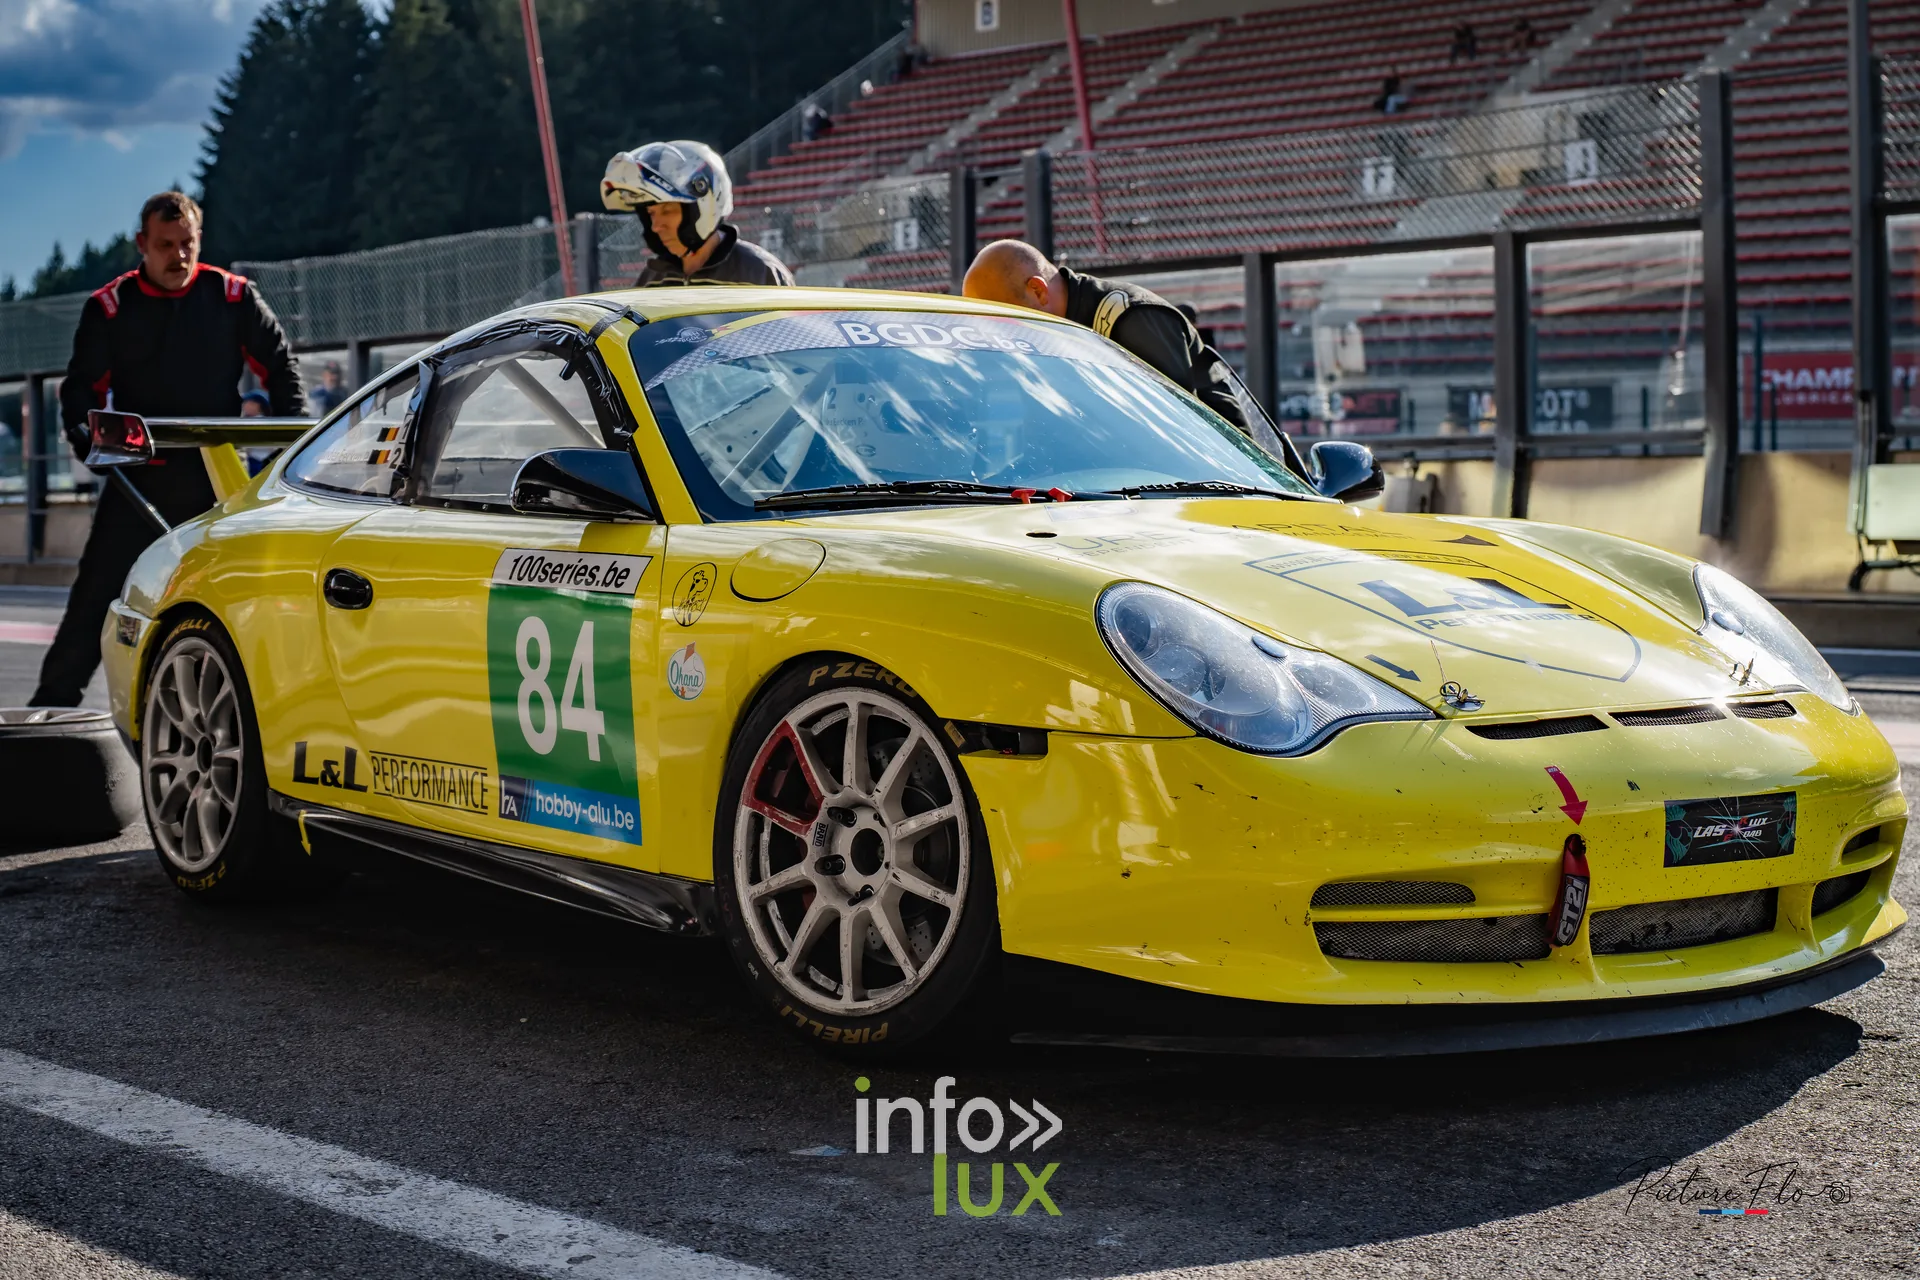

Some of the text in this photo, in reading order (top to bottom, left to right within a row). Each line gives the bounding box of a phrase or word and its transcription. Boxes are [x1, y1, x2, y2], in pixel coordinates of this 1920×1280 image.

[840, 322, 1035, 351] BGDC.be
[389, 448, 402, 469] 2
[508, 554, 631, 589] 100series.be
[1357, 576, 1573, 617] L&L
[1414, 612, 1600, 630] Performance
[515, 616, 605, 762] 84
[670, 660, 699, 687] Ohana
[292, 741, 489, 810] L&L PERFORMANCE
[535, 789, 635, 831] hobby-alu.be
[780, 1005, 889, 1044] PIRELLI
